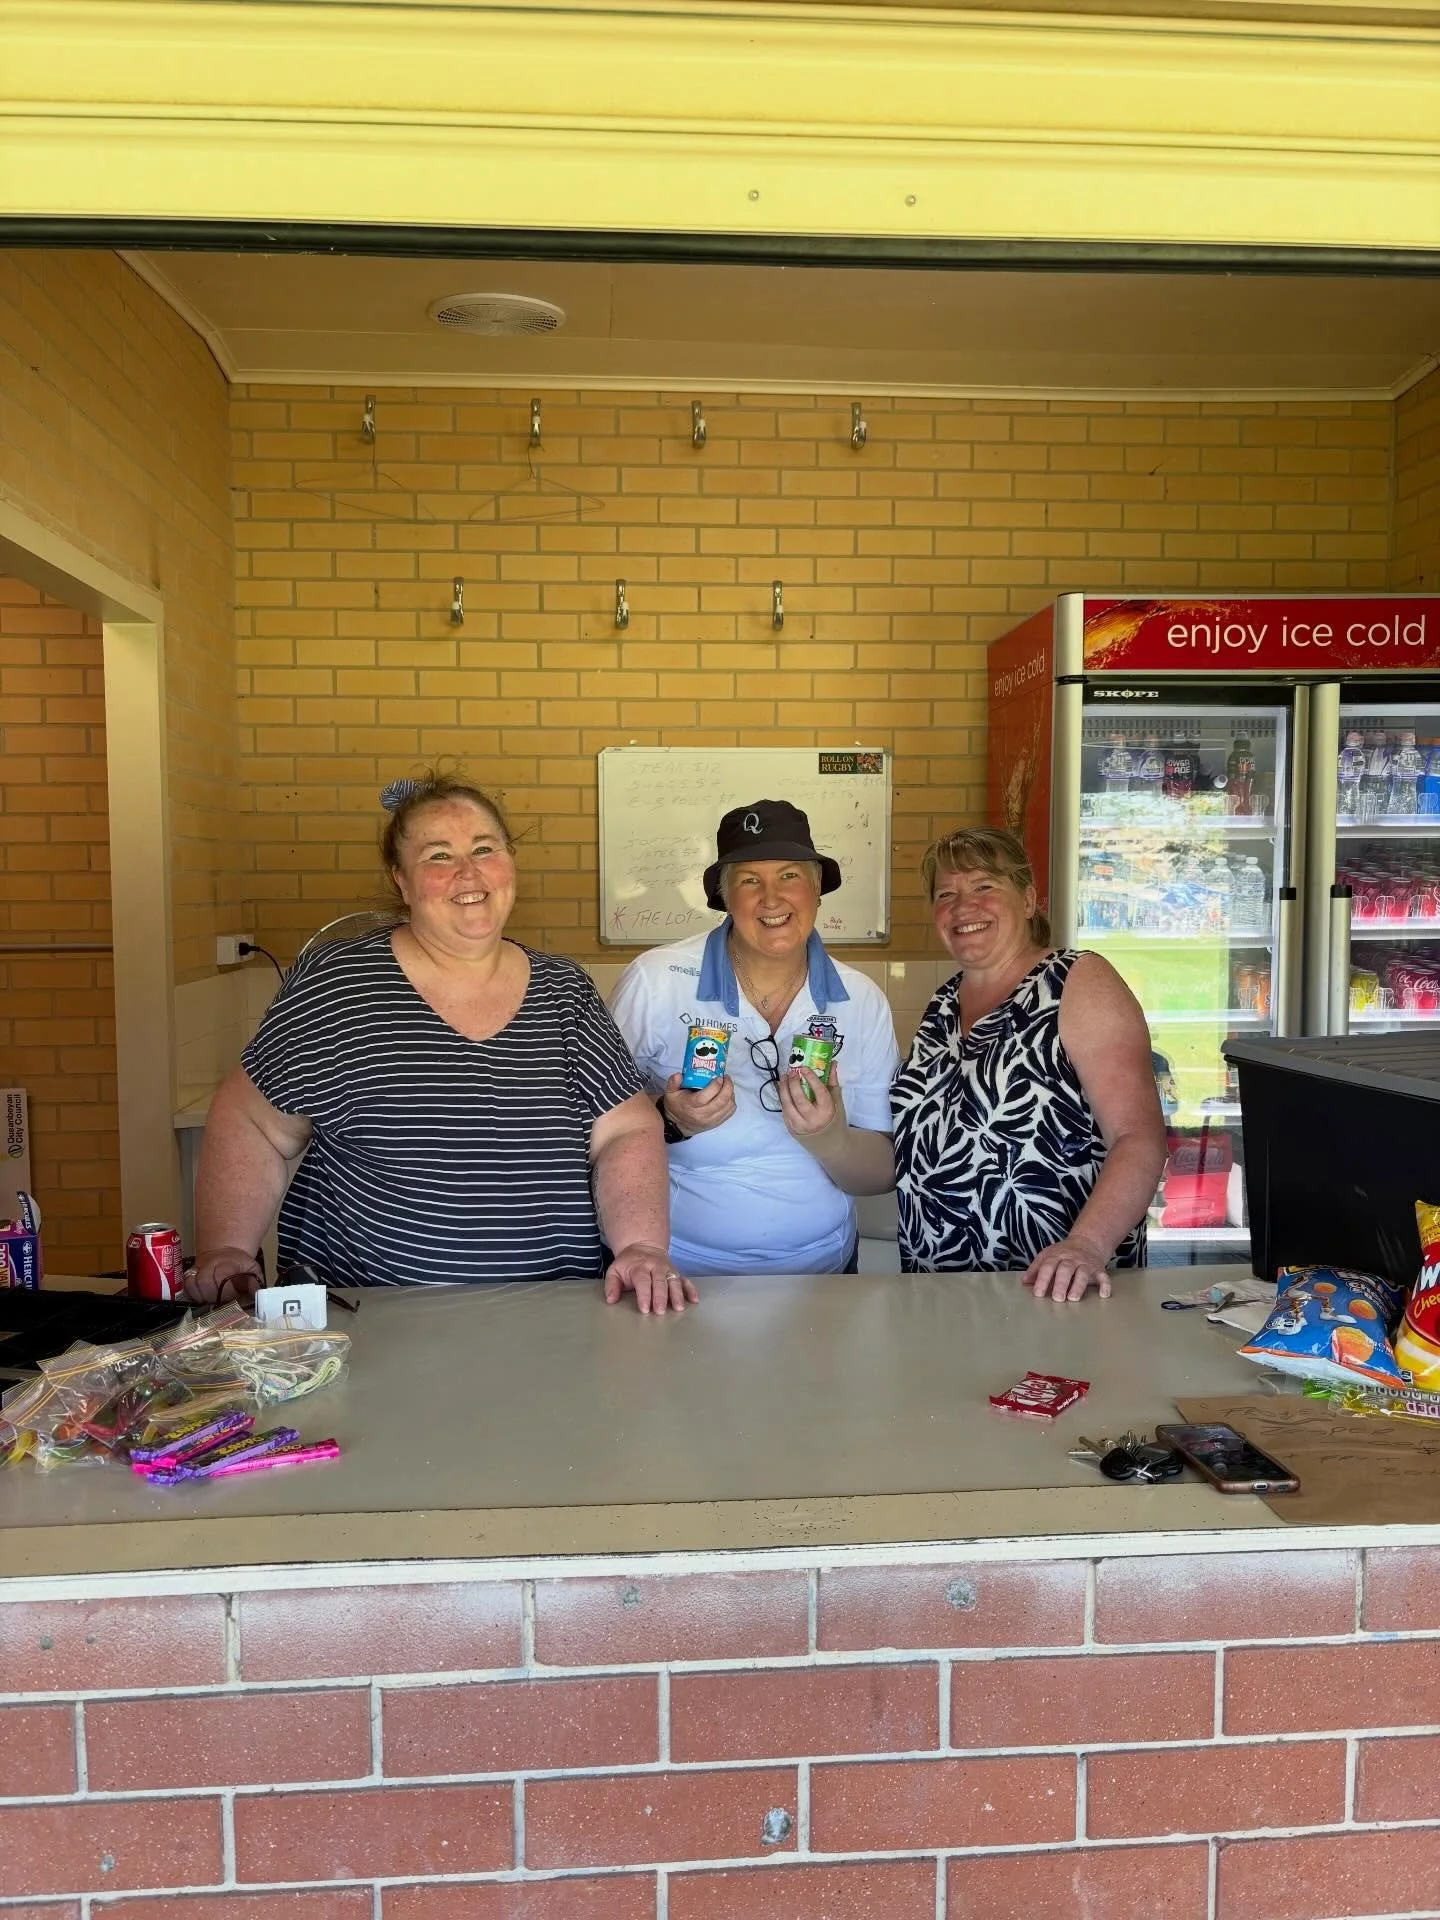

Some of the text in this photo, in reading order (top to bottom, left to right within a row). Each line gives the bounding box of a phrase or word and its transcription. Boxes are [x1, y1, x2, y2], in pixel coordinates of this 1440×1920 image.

[1167, 614, 1426, 653] enjoy ice cold
[994, 647, 1045, 697] enjoy ice cold
[1093, 688, 1159, 699] SKOPE
[821, 755, 854, 763] ROLL ON
[821, 763, 854, 772] RUGBY
[743, 812, 764, 835] Q
[632, 908, 662, 928] THE
[665, 905, 697, 926] LOT
[14, 1094, 24, 1144] City Council
